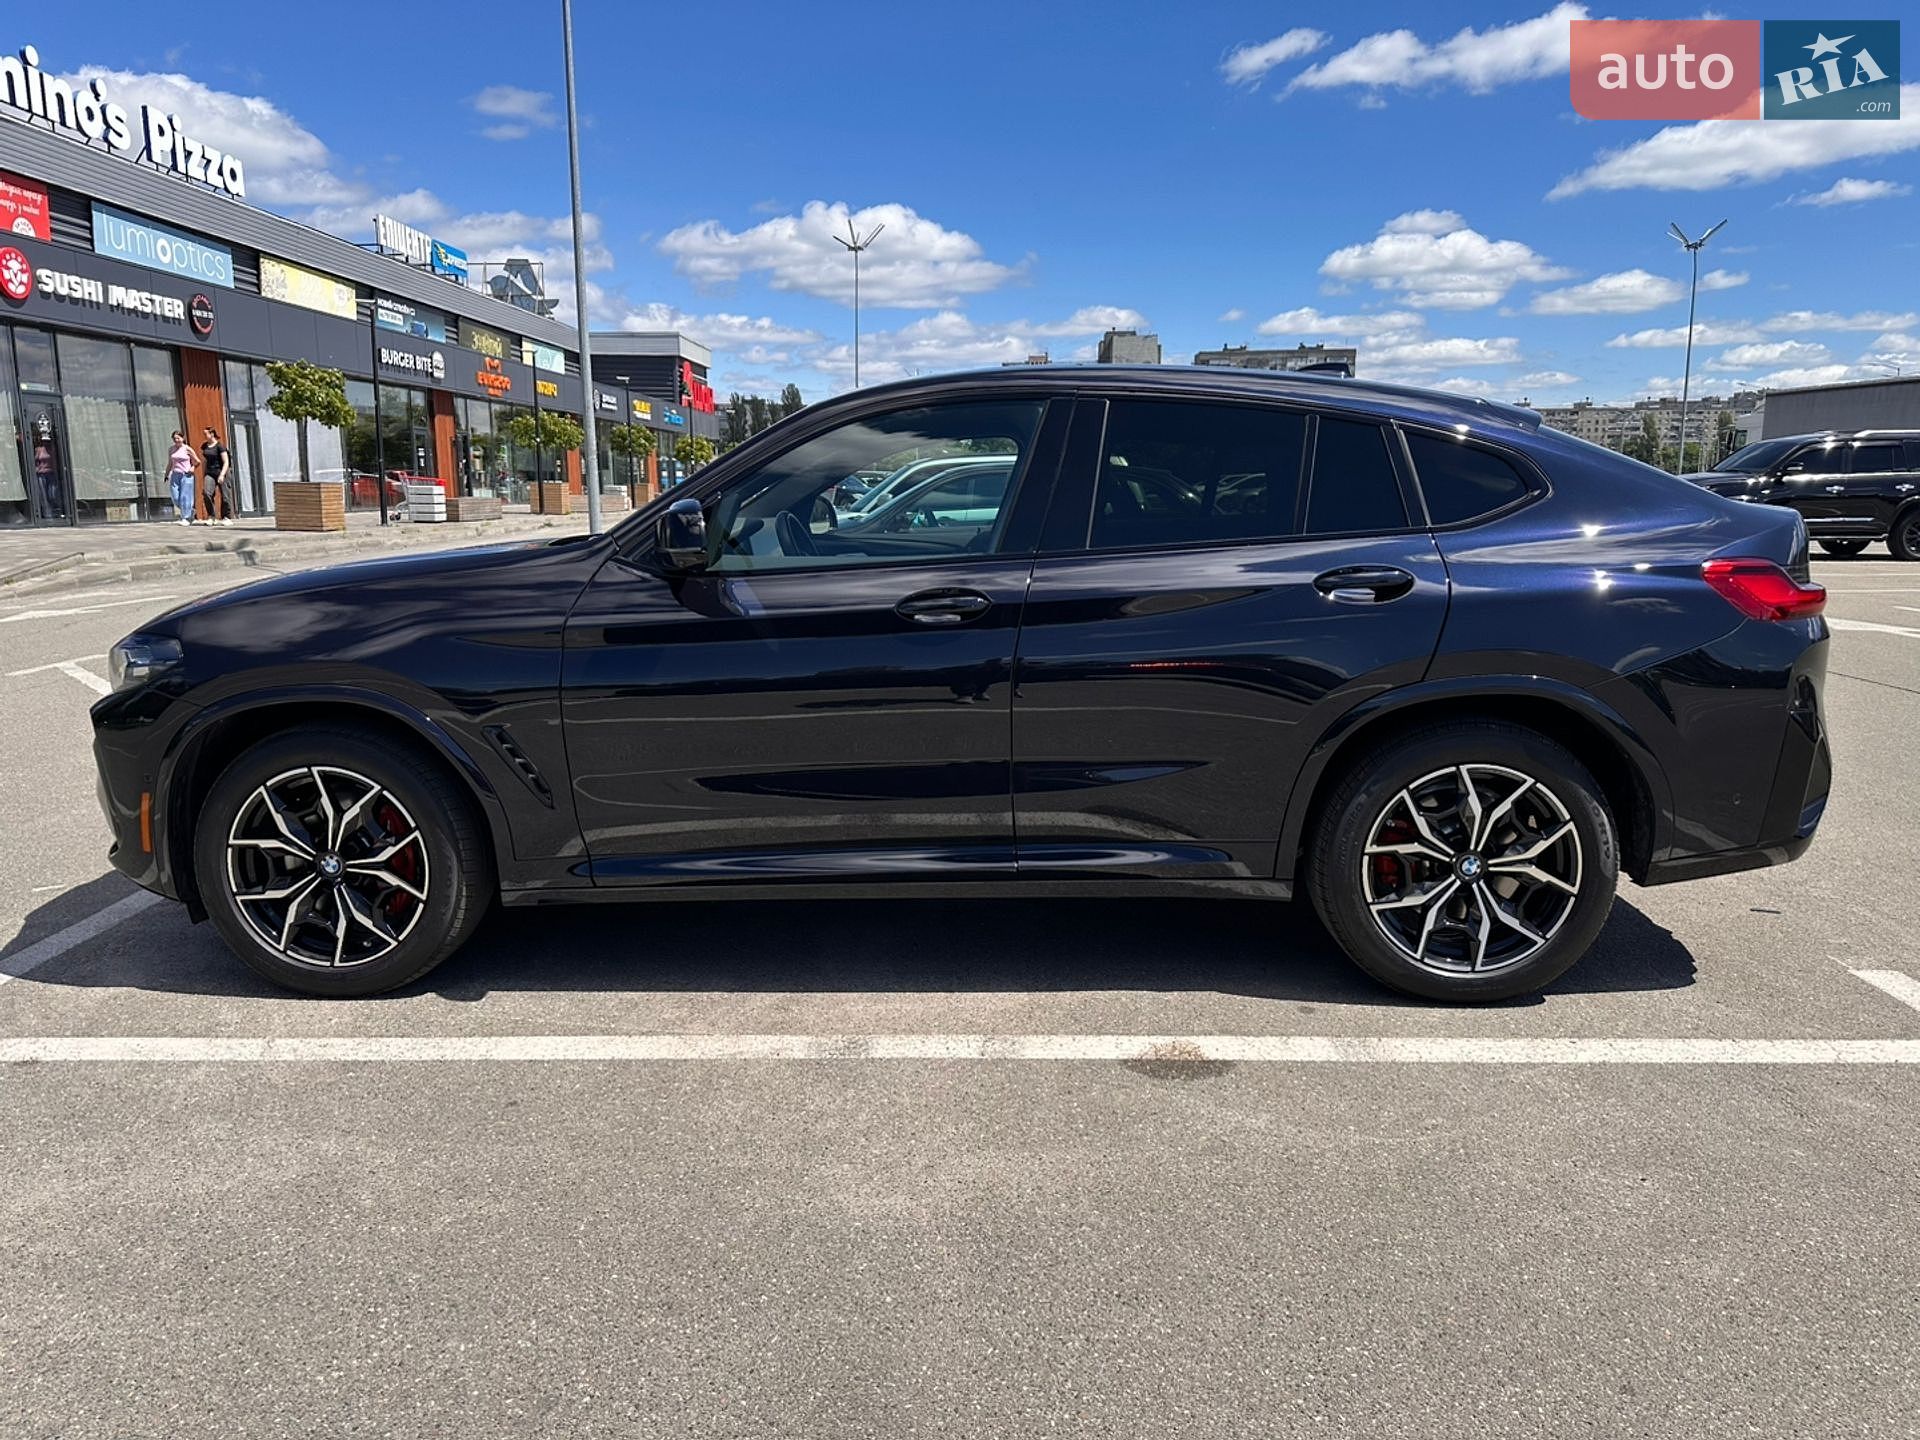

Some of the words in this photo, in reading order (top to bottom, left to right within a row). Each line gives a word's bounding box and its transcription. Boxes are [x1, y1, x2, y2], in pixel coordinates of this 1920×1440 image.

[142, 104, 245, 197] Pizza
[36, 268, 104, 304] SUSHI
[108, 285, 185, 321] MASTER
[381, 347, 415, 369] BURGER
[415, 355, 433, 373] BITE
